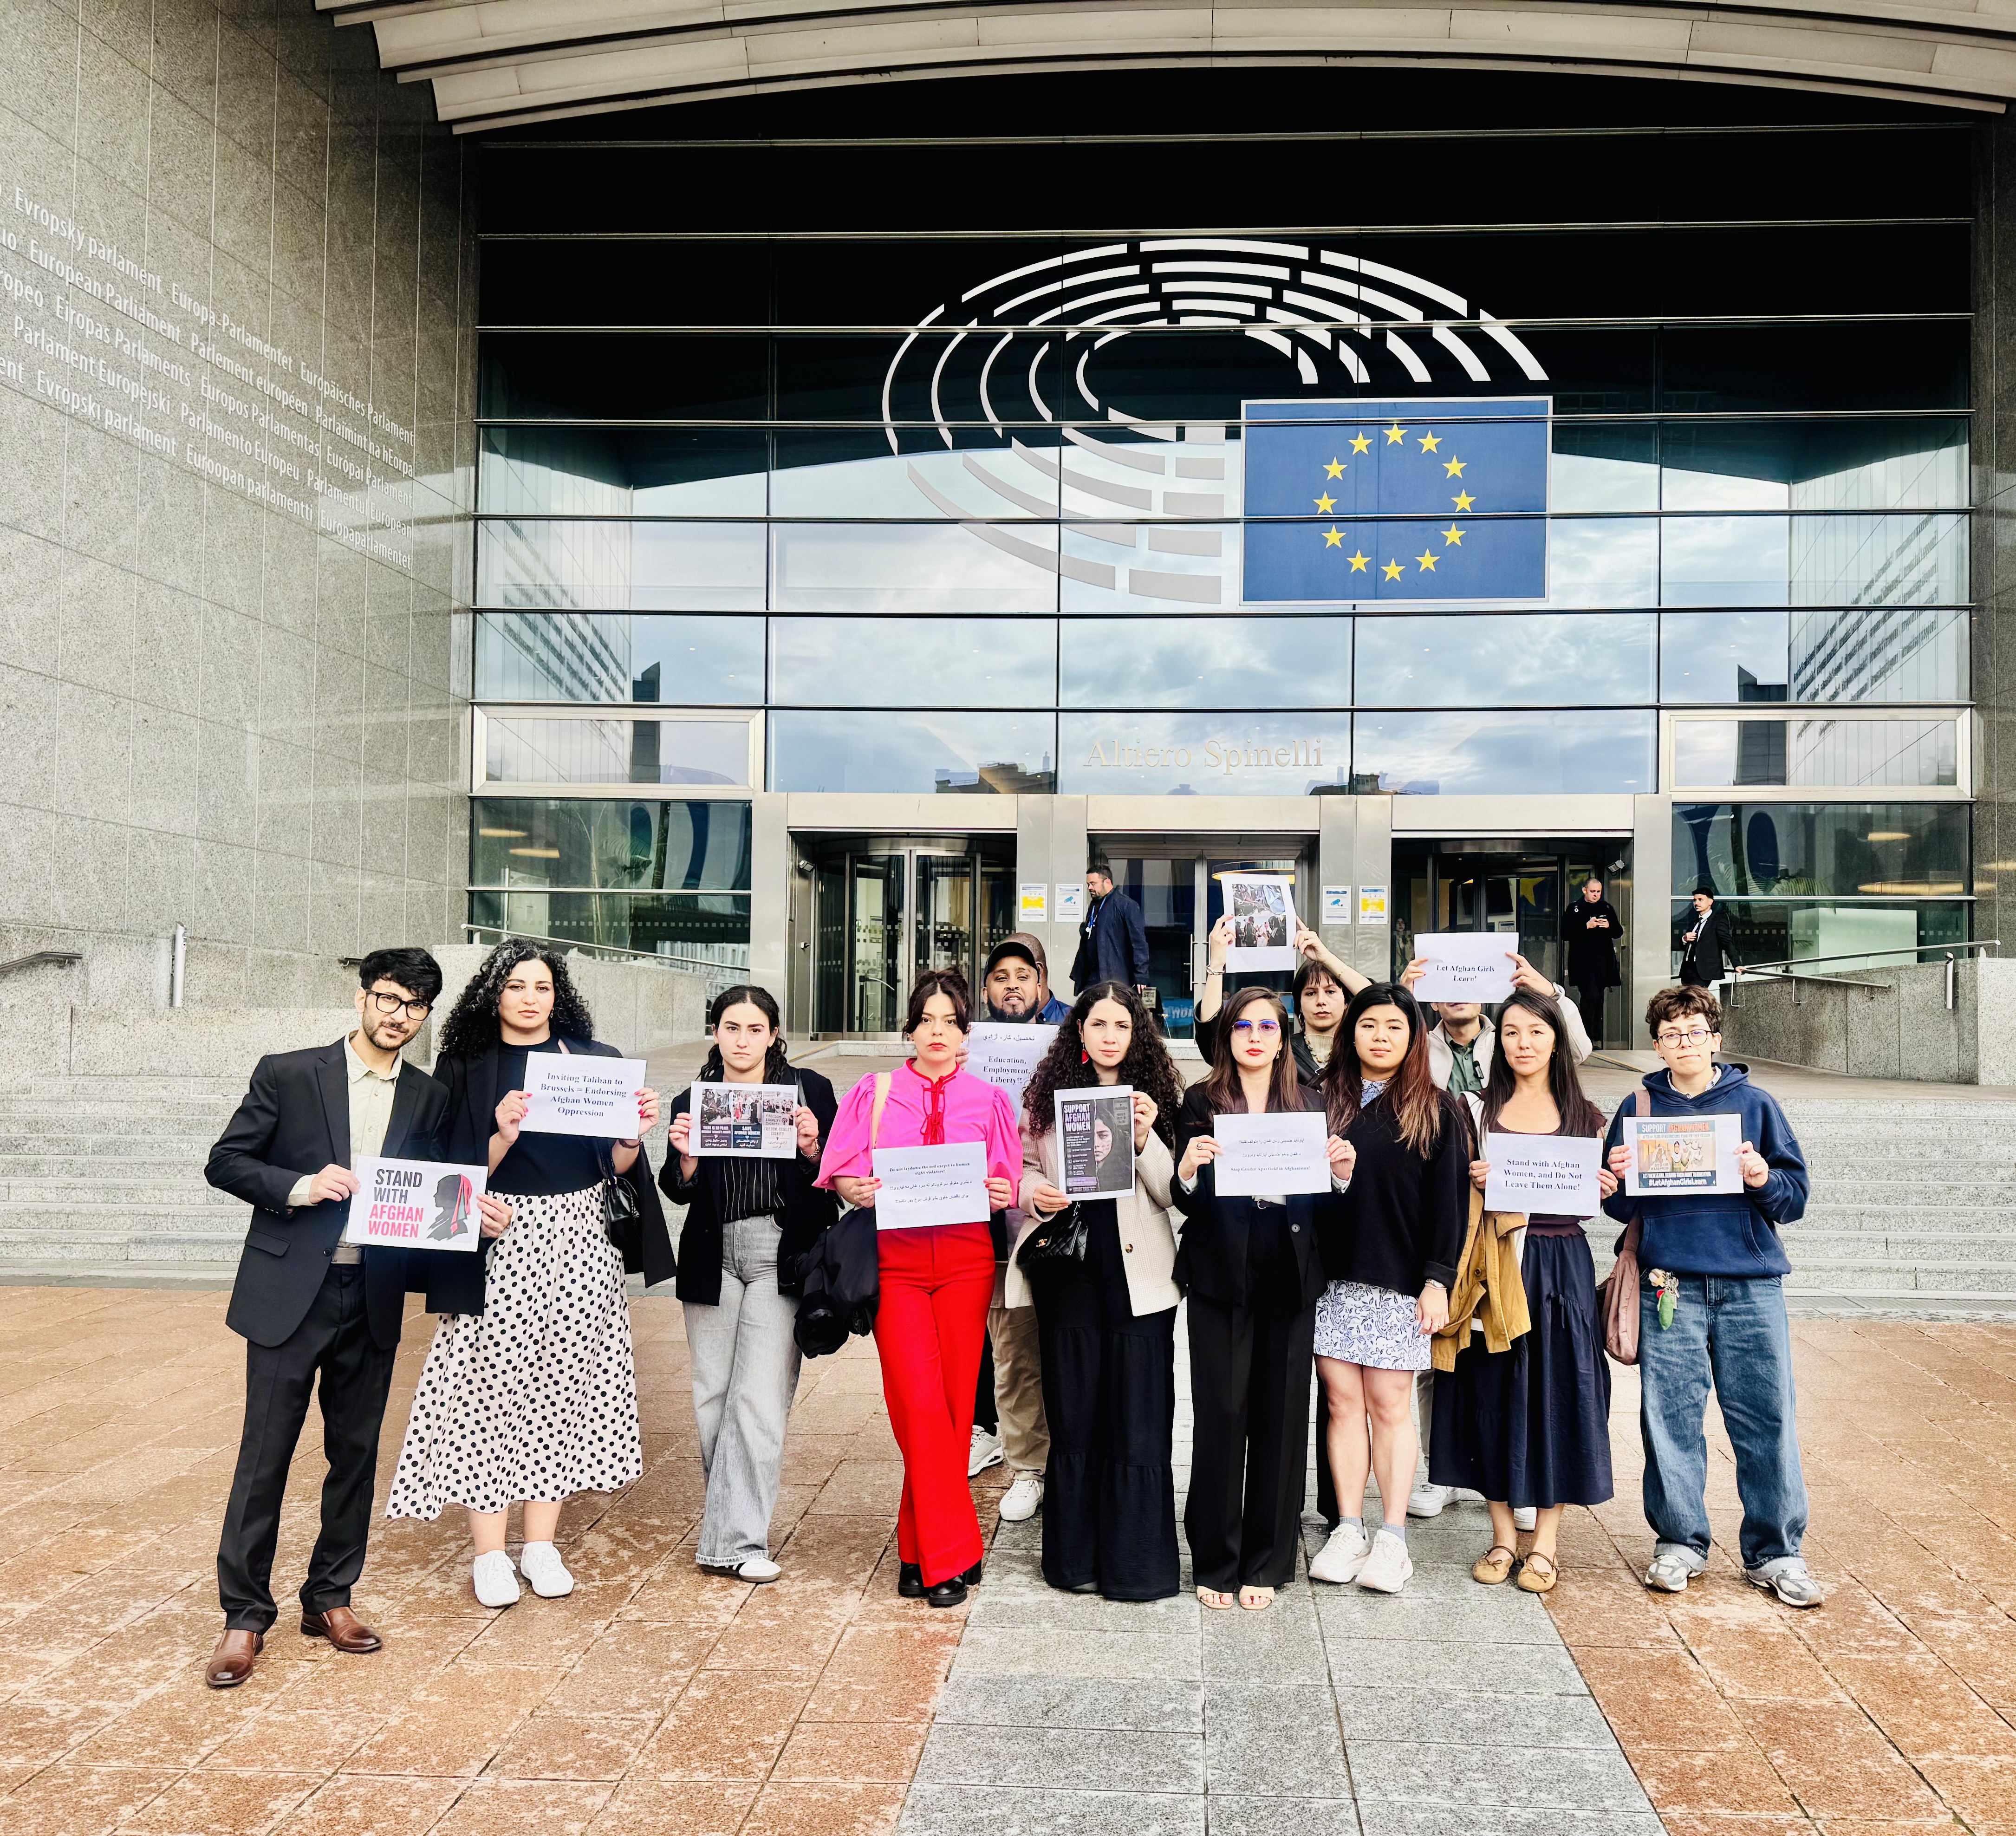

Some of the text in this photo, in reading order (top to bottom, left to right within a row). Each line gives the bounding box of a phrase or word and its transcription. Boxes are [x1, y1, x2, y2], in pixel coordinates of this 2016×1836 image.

[15, 187, 414, 447] Evropský parlament Europa-Parlamentet Europäisches Parlament
[30, 239, 101, 299] European
[106, 283, 181, 345] Parliament
[191, 332, 254, 386] Parlement
[257, 376, 308, 417] européen
[370, 441, 380, 459] na
[383, 444, 413, 479] hEorpa
[56, 295, 111, 344] Eiropas
[115, 327, 190, 387] Parlaments
[201, 375, 249, 418] Europos
[252, 403, 319, 457] Parlamentas
[327, 445, 364, 482] Európai
[366, 467, 412, 508] Parlament
[14, 315, 412, 539] Parlament Europejski Parlamento Europeu Parlamentul European
[37, 370, 100, 420] Evropski
[105, 408, 177, 456] parlament
[187, 444, 244, 488] Euroopan
[247, 477, 313, 522] parlamentti
[320, 509, 411, 570] Europaparlamentet
[1083, 738, 1323, 775] Altiero Spinelli
[988, 1056, 1027, 1064] Education,
[547, 1073, 579, 1083] Inviting
[582, 1075, 612, 1085] Taliban
[541, 1083, 574, 1093] Brussels
[585, 1087, 627, 1097] Endorsing
[550, 1095, 614, 1107] Afghan Women
[1063, 1103, 1090, 1113] SUPPORT
[558, 1107, 604, 1117] Oppression
[1065, 1112, 1090, 1122] AFGHAN
[1065, 1121, 1091, 1132] WOMEN
[1642, 1124, 1666, 1133] SUPPORT
[1667, 1123, 1690, 1133] AFGHAN
[1551, 1161, 1580, 1170] Afghan
[375, 1169, 423, 1188] STAND
[1504, 1169, 1535, 1178] Women,
[374, 1187, 408, 1204] WITH
[369, 1204, 424, 1222] AFGHAN
[368, 1220, 419, 1238] WOMEN
